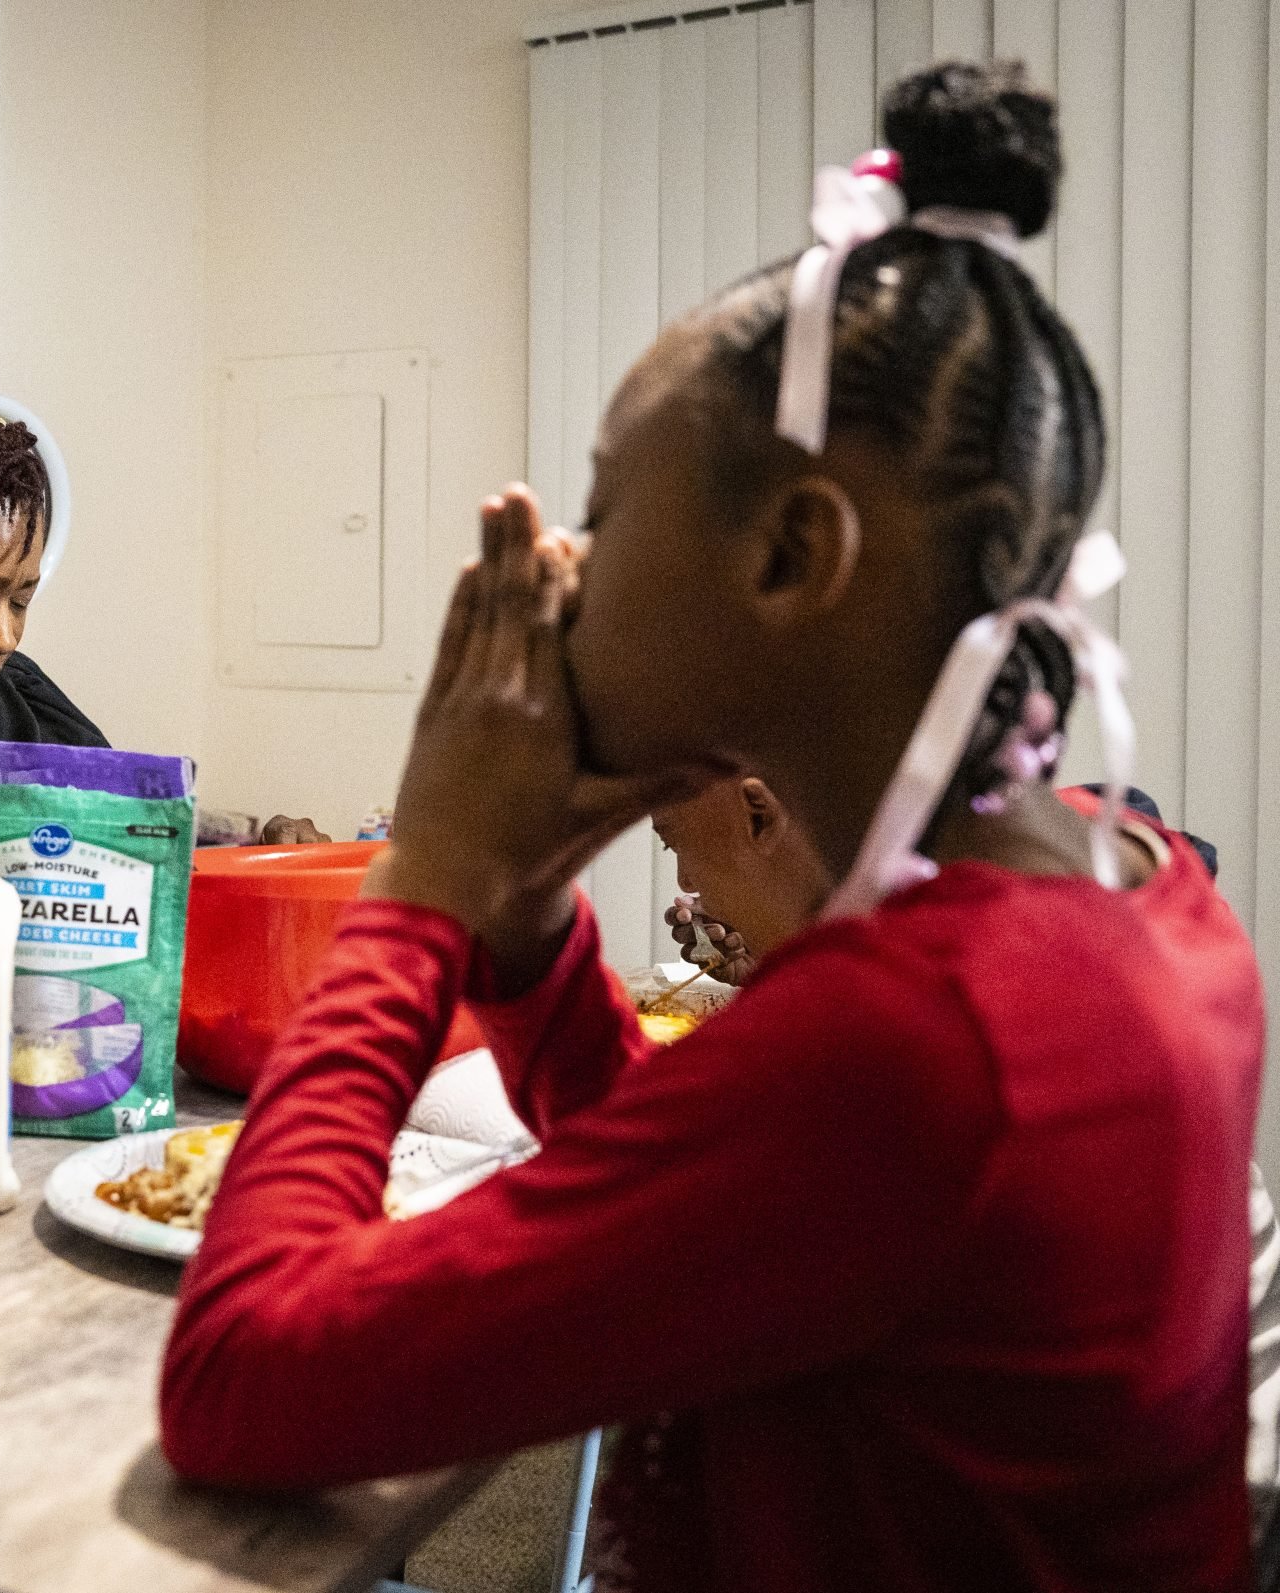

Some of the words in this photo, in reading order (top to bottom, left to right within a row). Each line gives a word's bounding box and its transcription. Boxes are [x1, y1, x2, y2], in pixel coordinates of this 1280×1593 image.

[33, 828, 70, 852] Kroger
[5, 861, 99, 879] LOW-MOISTURE
[51, 882, 91, 897] SKIM
[20, 899, 140, 926] ZARELLA
[59, 929, 122, 945] CHEESE
